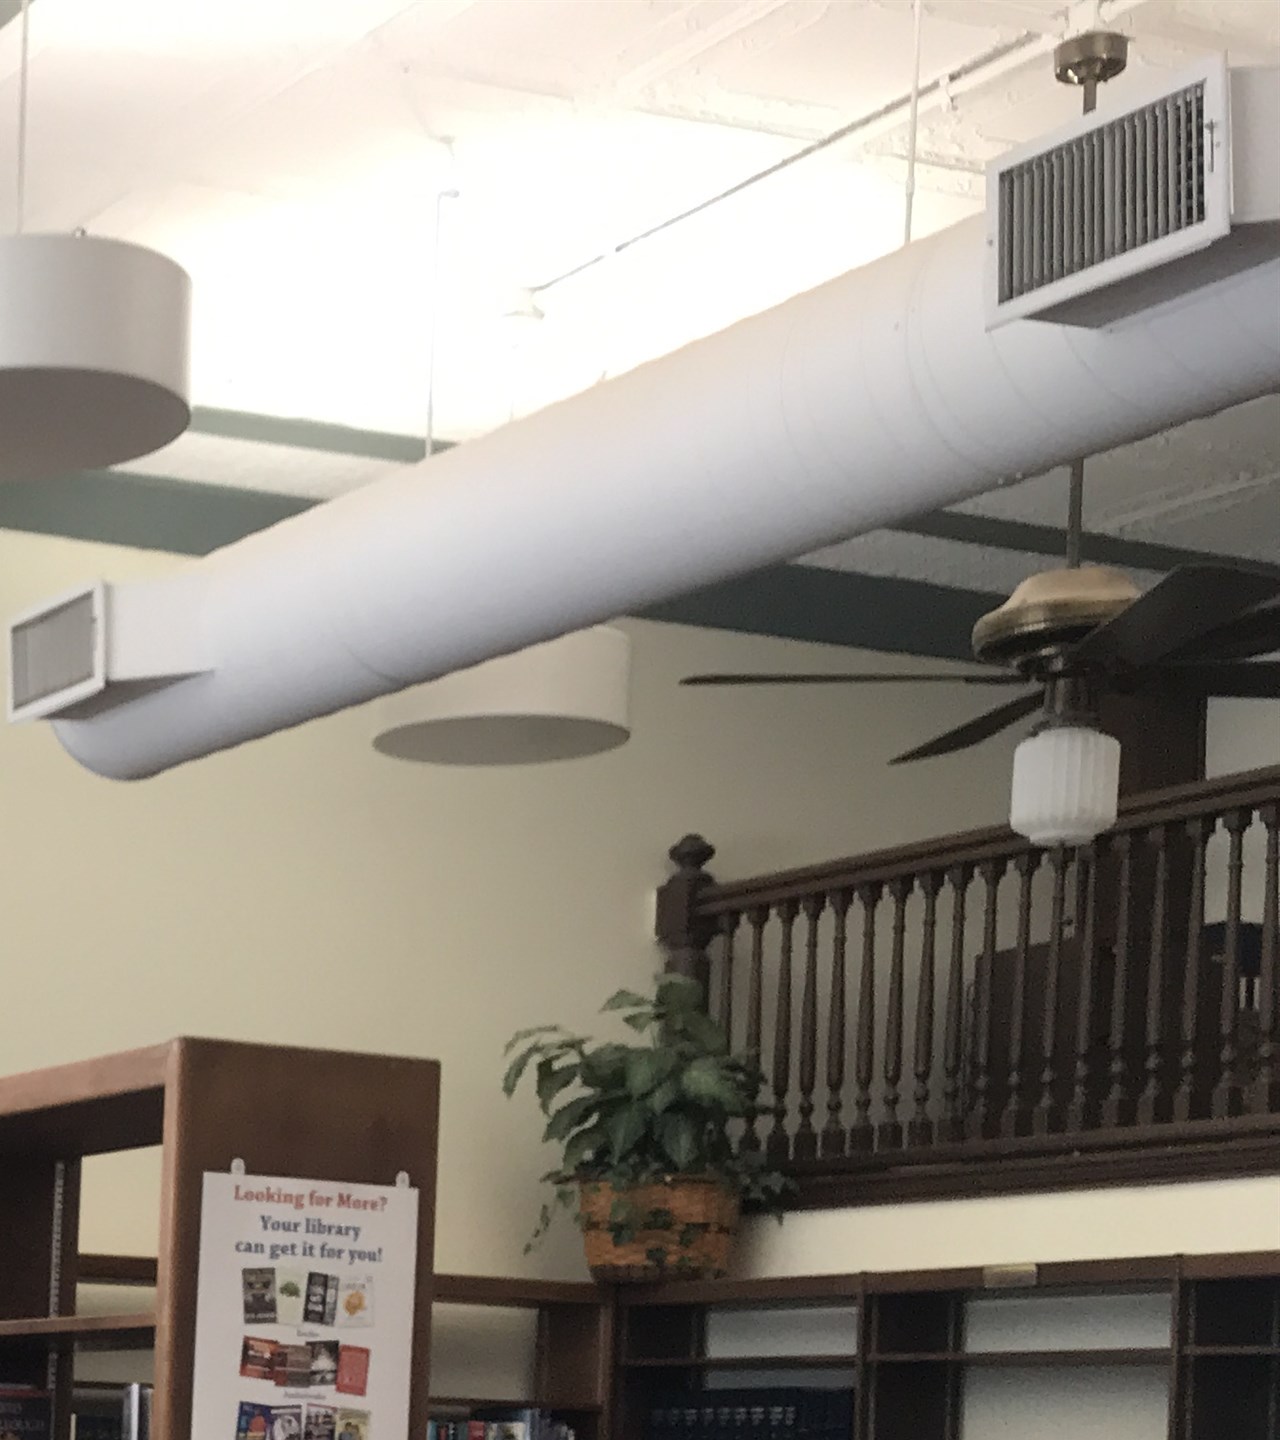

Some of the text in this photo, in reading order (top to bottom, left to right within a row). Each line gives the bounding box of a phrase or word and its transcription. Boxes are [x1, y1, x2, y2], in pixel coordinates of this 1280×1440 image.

[234, 1184, 388, 1211] Looking for More?
[260, 1215, 361, 1242] Your library
[235, 1240, 383, 1265] can get it for you!
